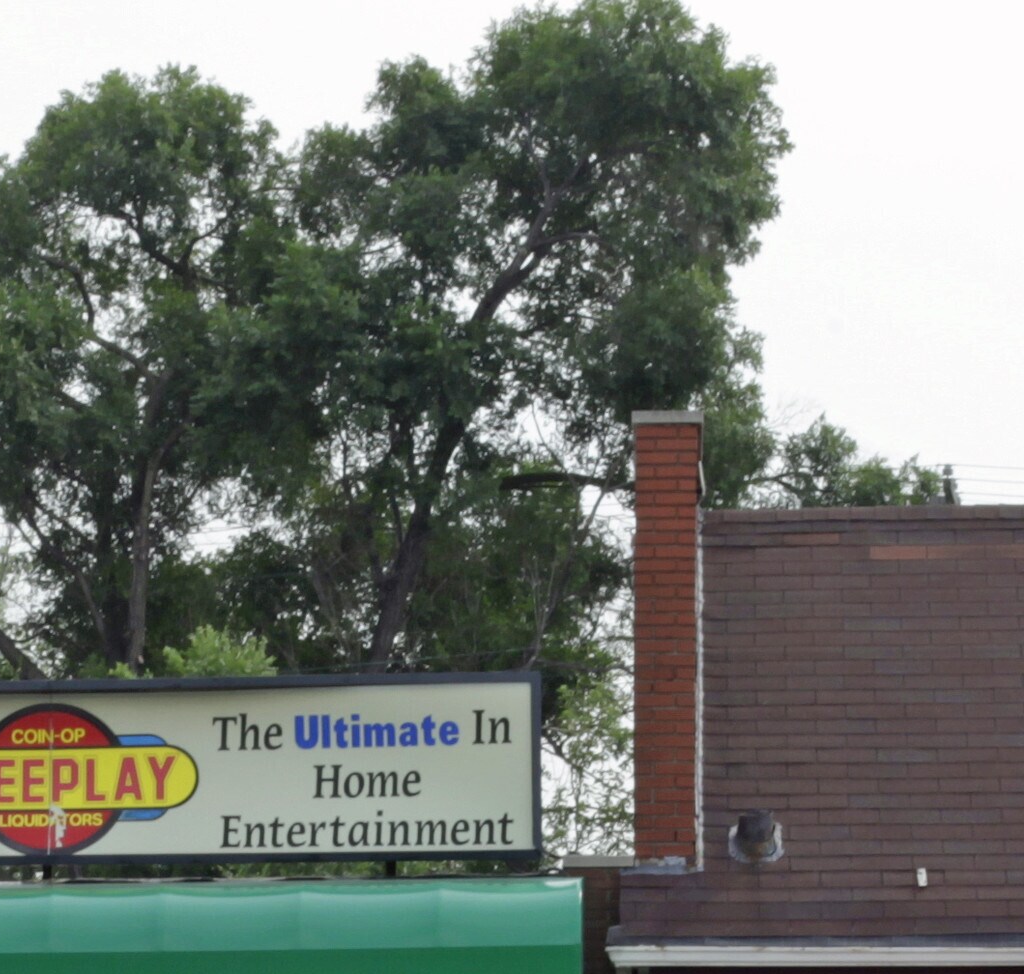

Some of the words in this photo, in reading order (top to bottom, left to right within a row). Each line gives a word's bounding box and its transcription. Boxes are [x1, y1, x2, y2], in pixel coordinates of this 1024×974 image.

[10, 727, 86, 745] COIN-OP
[212, 713, 283, 751] The
[294, 713, 460, 749] Ultimate
[472, 709, 512, 745] In
[313, 764, 422, 799] Home
[220, 810, 514, 849] Entertainment
